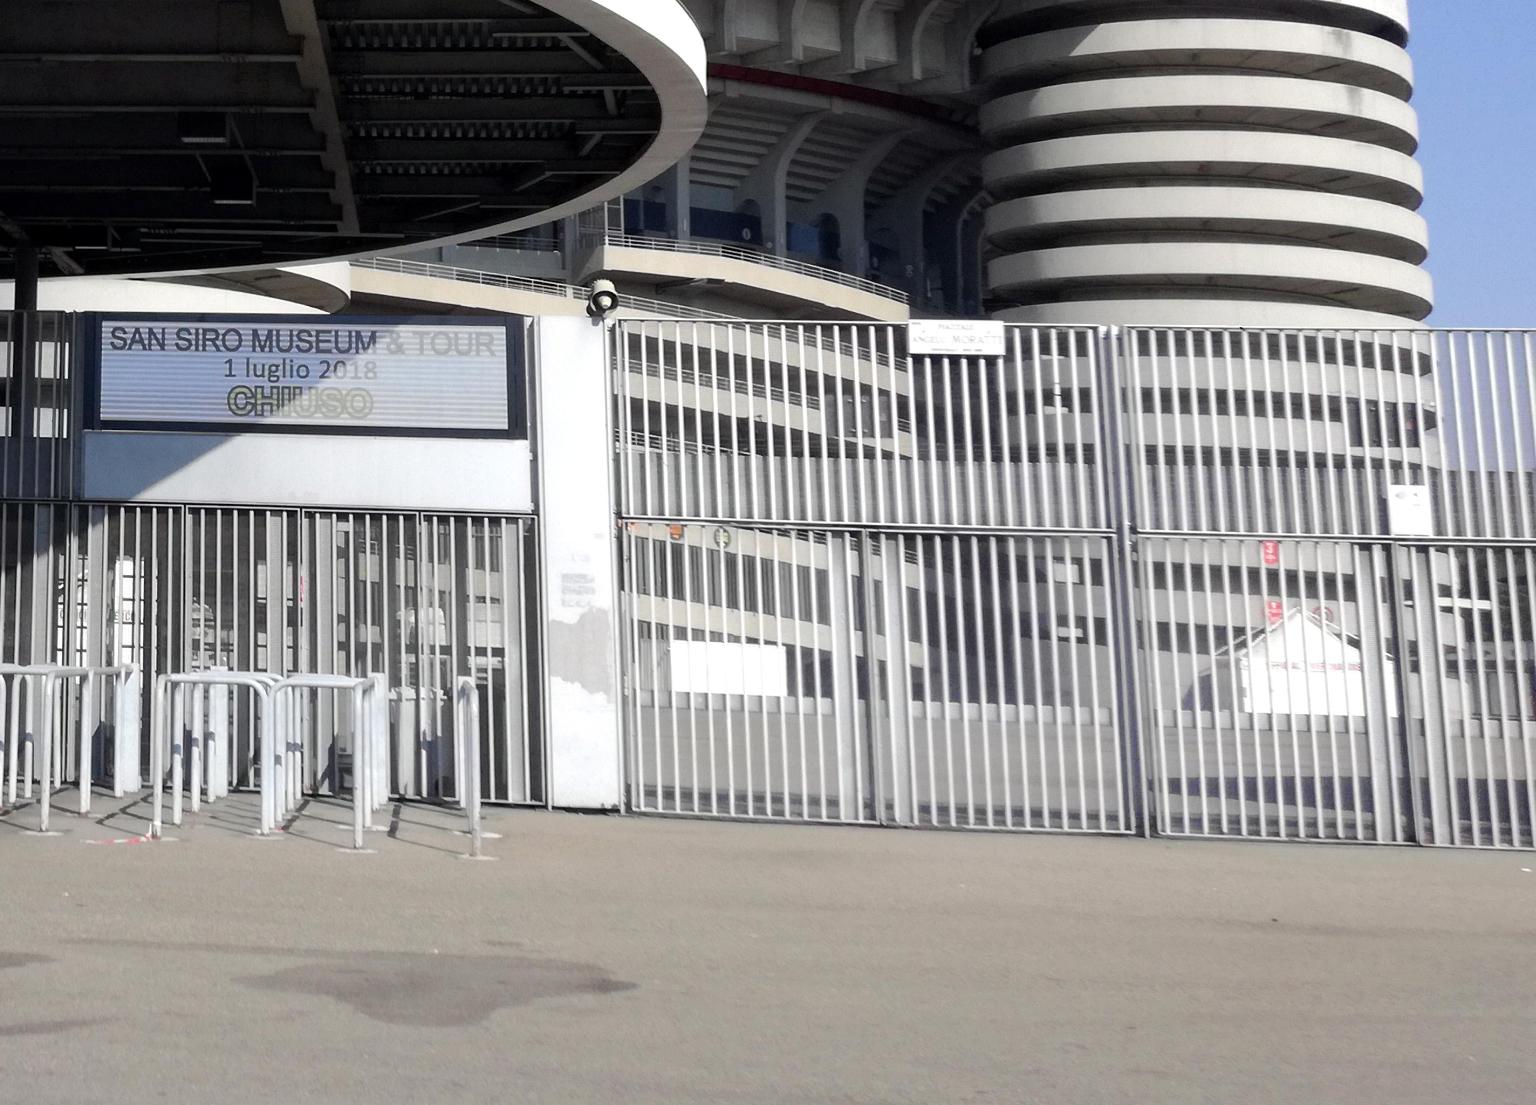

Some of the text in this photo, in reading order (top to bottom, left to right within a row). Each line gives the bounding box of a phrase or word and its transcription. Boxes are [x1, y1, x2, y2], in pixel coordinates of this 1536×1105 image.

[109, 326, 497, 357] SAN SIRO MUSEUM & TOUR
[224, 357, 378, 383] 1 luglio 2018
[226, 384, 374, 419] CHIUSO
